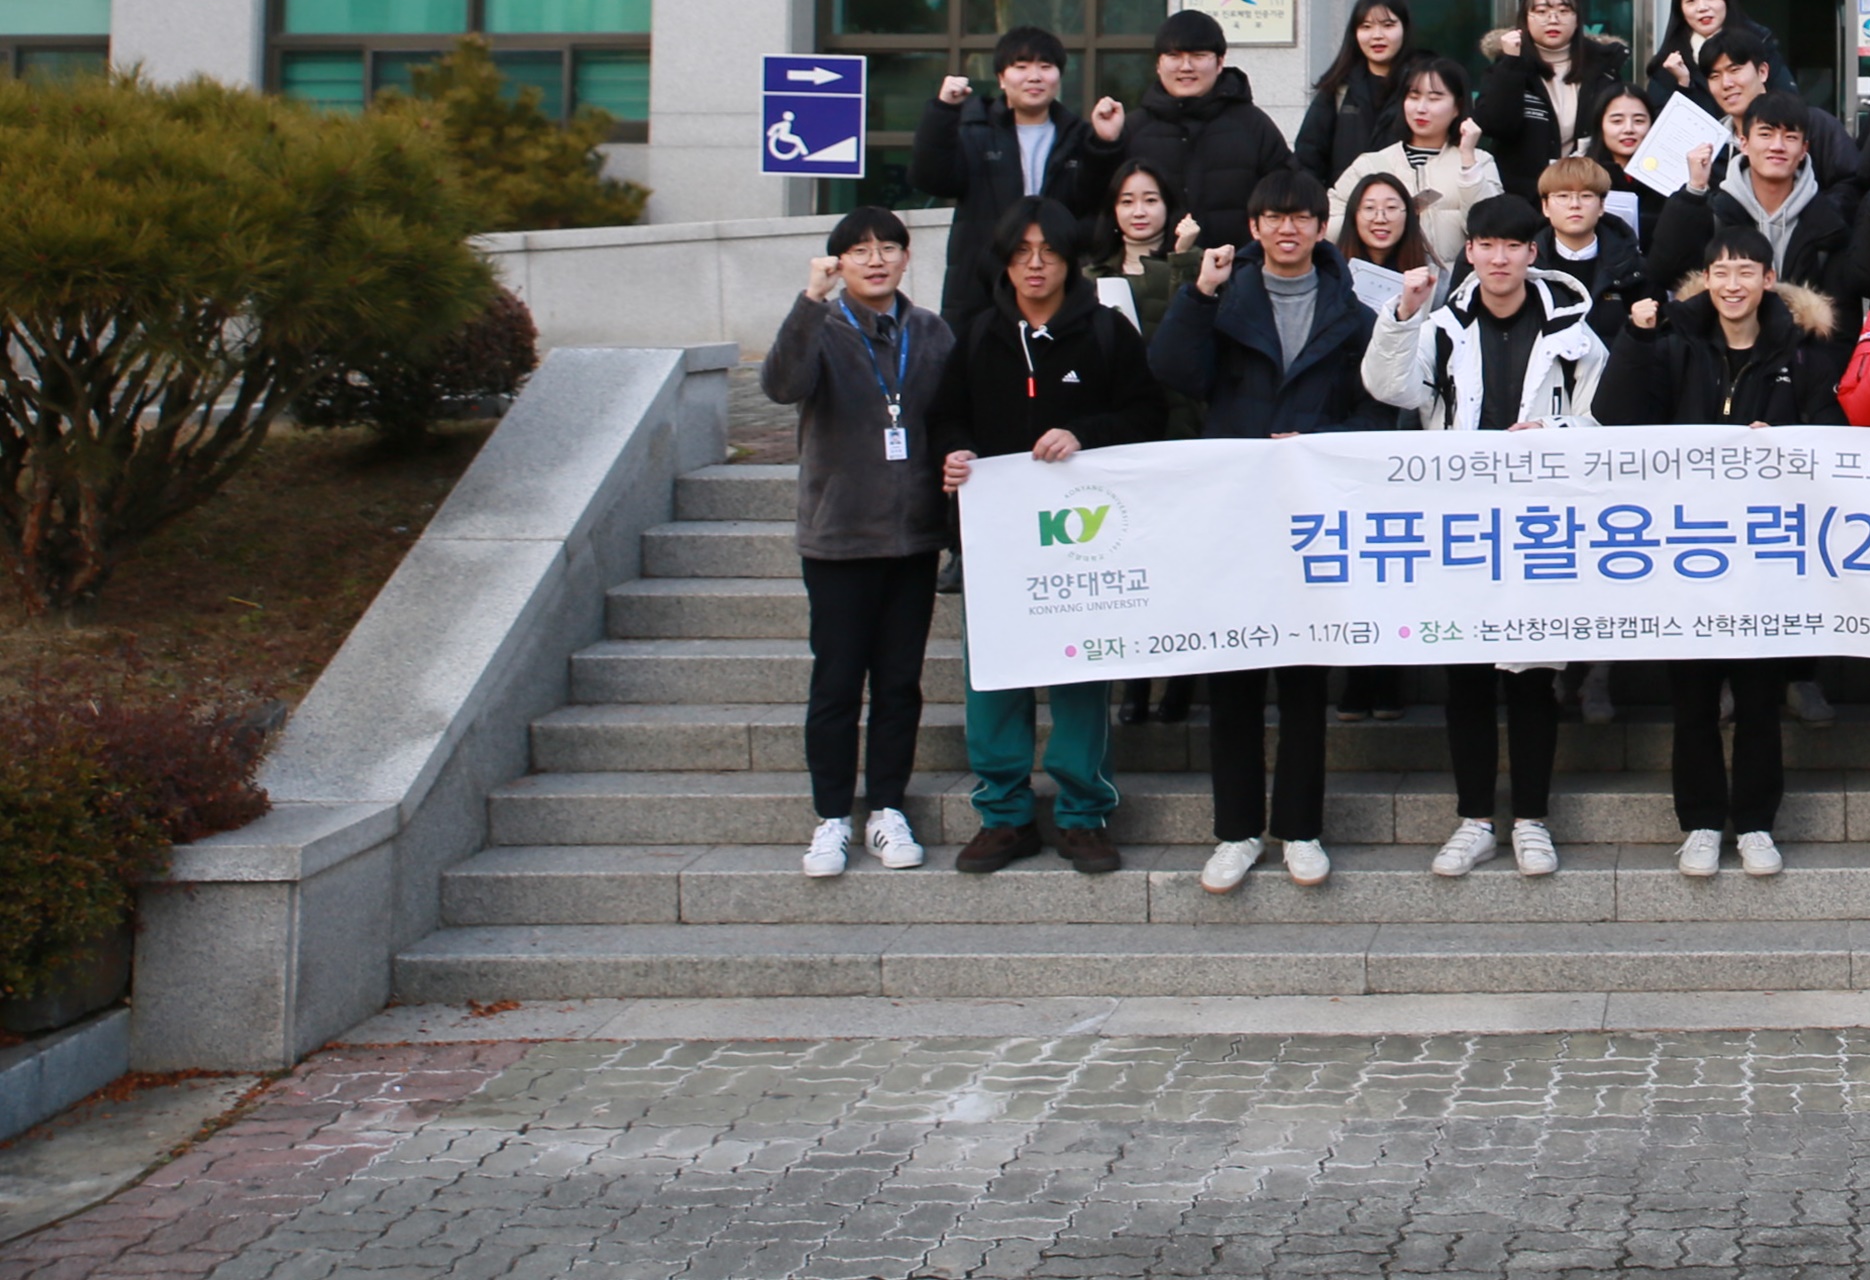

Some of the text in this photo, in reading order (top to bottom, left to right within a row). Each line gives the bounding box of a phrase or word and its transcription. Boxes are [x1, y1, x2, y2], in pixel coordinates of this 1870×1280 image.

[1387, 450, 1570, 484] 2019학년도
[1583, 446, 1819, 482] 커리어역량강화
[1038, 505, 1111, 547] KY
[1026, 569, 1150, 601] 건양대학교
[1028, 597, 1150, 616] KONYANG UNIVERSITY
[1082, 635, 1126, 662] 일자
[1148, 623, 1279, 655] 2020.1.8(수)
[1308, 620, 1380, 645] 1.17(금)
[1418, 620, 1464, 644] 장소
[1692, 612, 1825, 638] 산학취업본부
